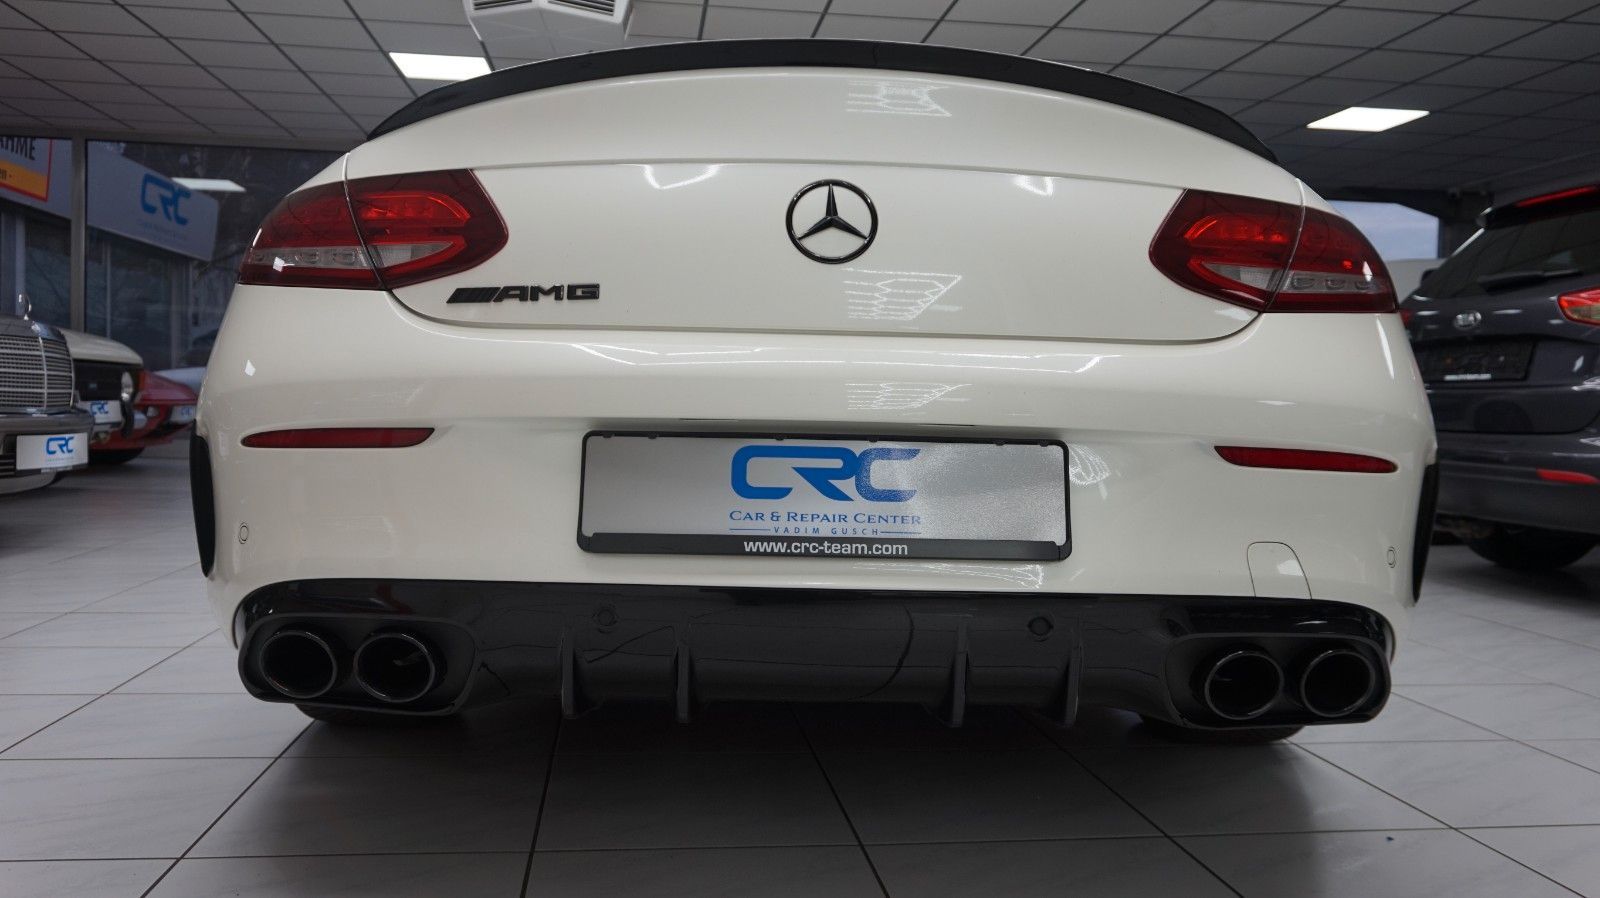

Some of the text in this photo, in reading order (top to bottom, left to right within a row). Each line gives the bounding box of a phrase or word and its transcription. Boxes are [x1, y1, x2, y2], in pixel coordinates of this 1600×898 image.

[142, 173, 191, 225] CRC
[493, 284, 600, 302] AMG
[46, 436, 74, 454] CRC
[731, 445, 921, 502] CRC
[729, 510, 921, 525] CAR & REPAIR CENTER
[774, 526, 878, 535] VADIM GUSCH
[743, 540, 908, 555] www.crc-team.com
